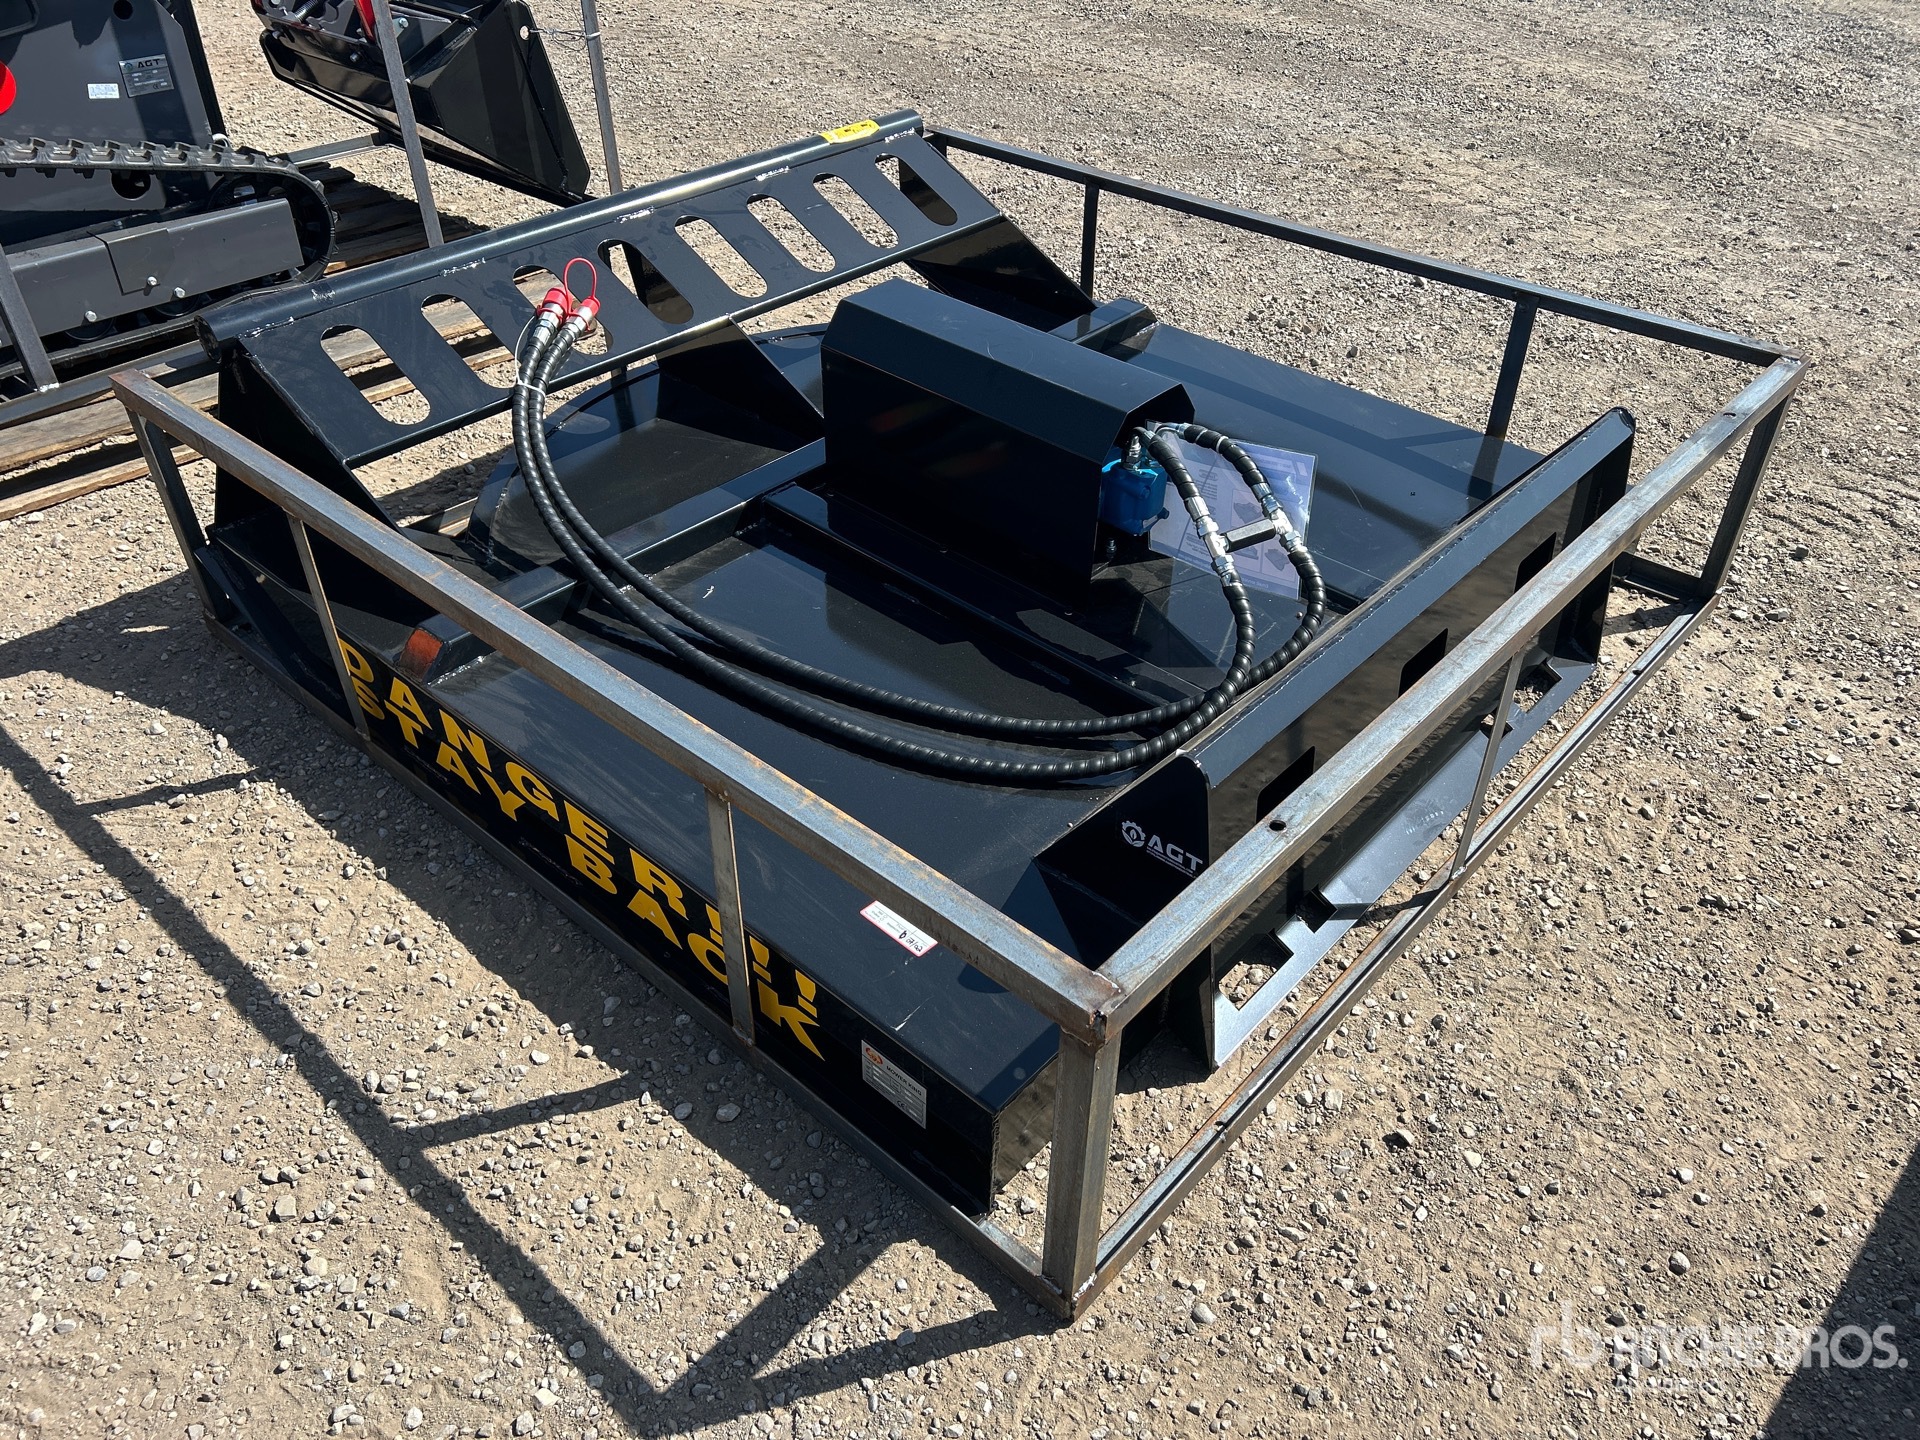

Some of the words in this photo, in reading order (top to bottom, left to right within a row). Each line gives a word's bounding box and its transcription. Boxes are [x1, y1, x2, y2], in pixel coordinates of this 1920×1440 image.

[137, 58, 161, 69] AGT
[338, 637, 818, 1019] DANGER!!!
[350, 676, 527, 822] STAY
[563, 833, 827, 1062] BACK
[1147, 834, 1204, 871] AGT
